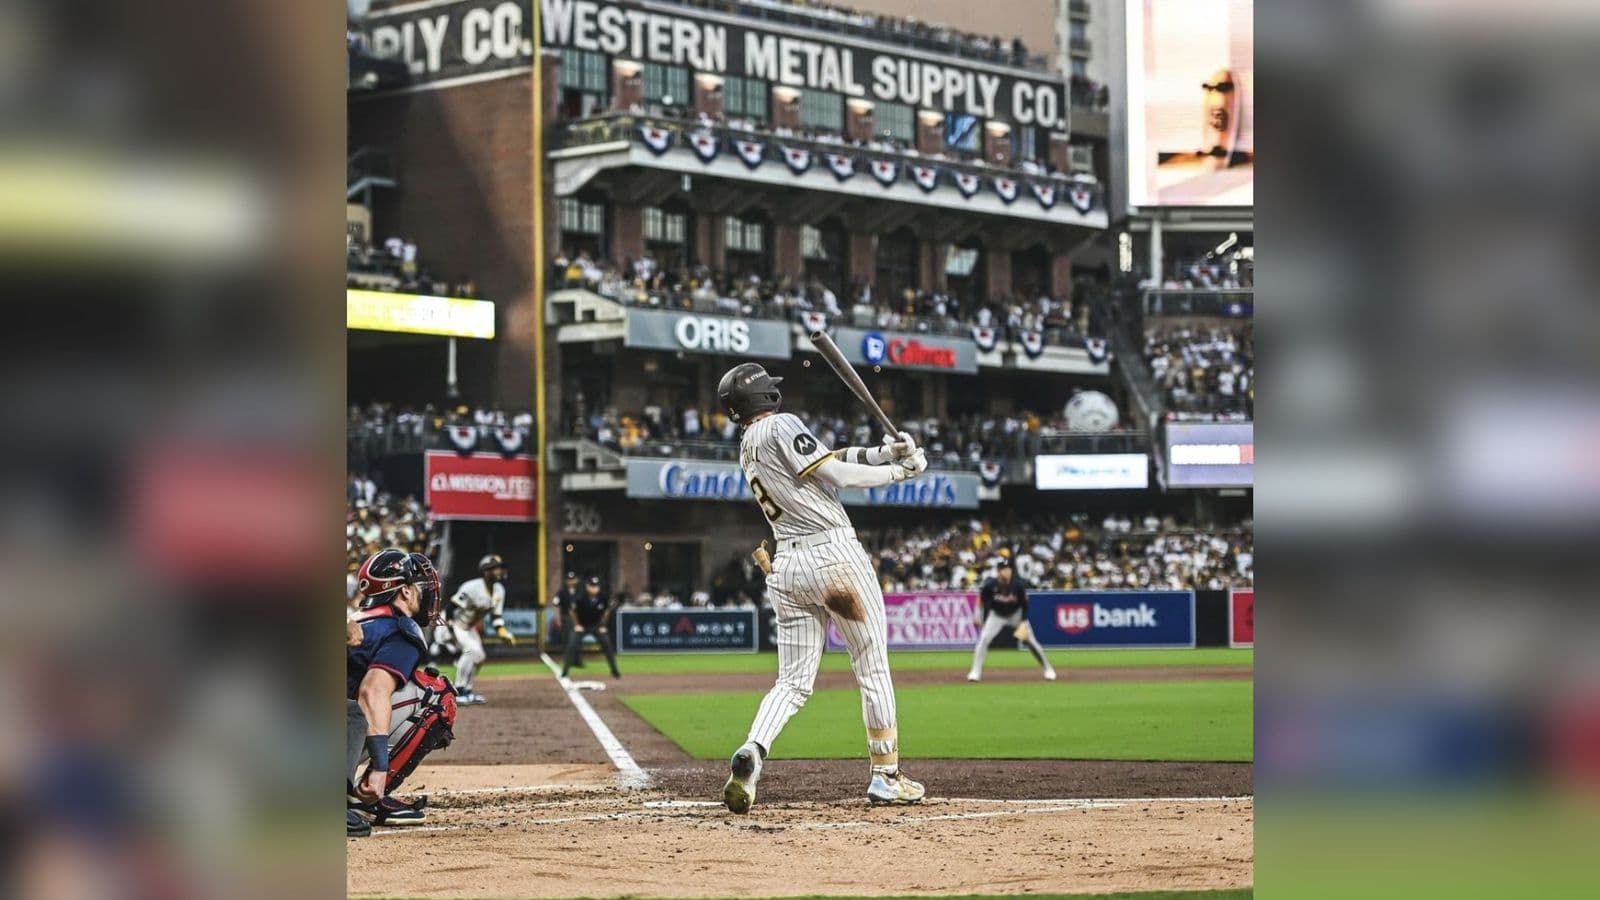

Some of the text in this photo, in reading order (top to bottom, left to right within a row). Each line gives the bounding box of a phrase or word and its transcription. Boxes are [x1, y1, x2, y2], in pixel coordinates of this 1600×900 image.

[462, 2, 533, 64] CO.
[541, 0, 1066, 130] WESTERN METAL SUPPLY CO.
[674, 315, 751, 353] ORIS
[1057, 603, 1157, 628] us bank
